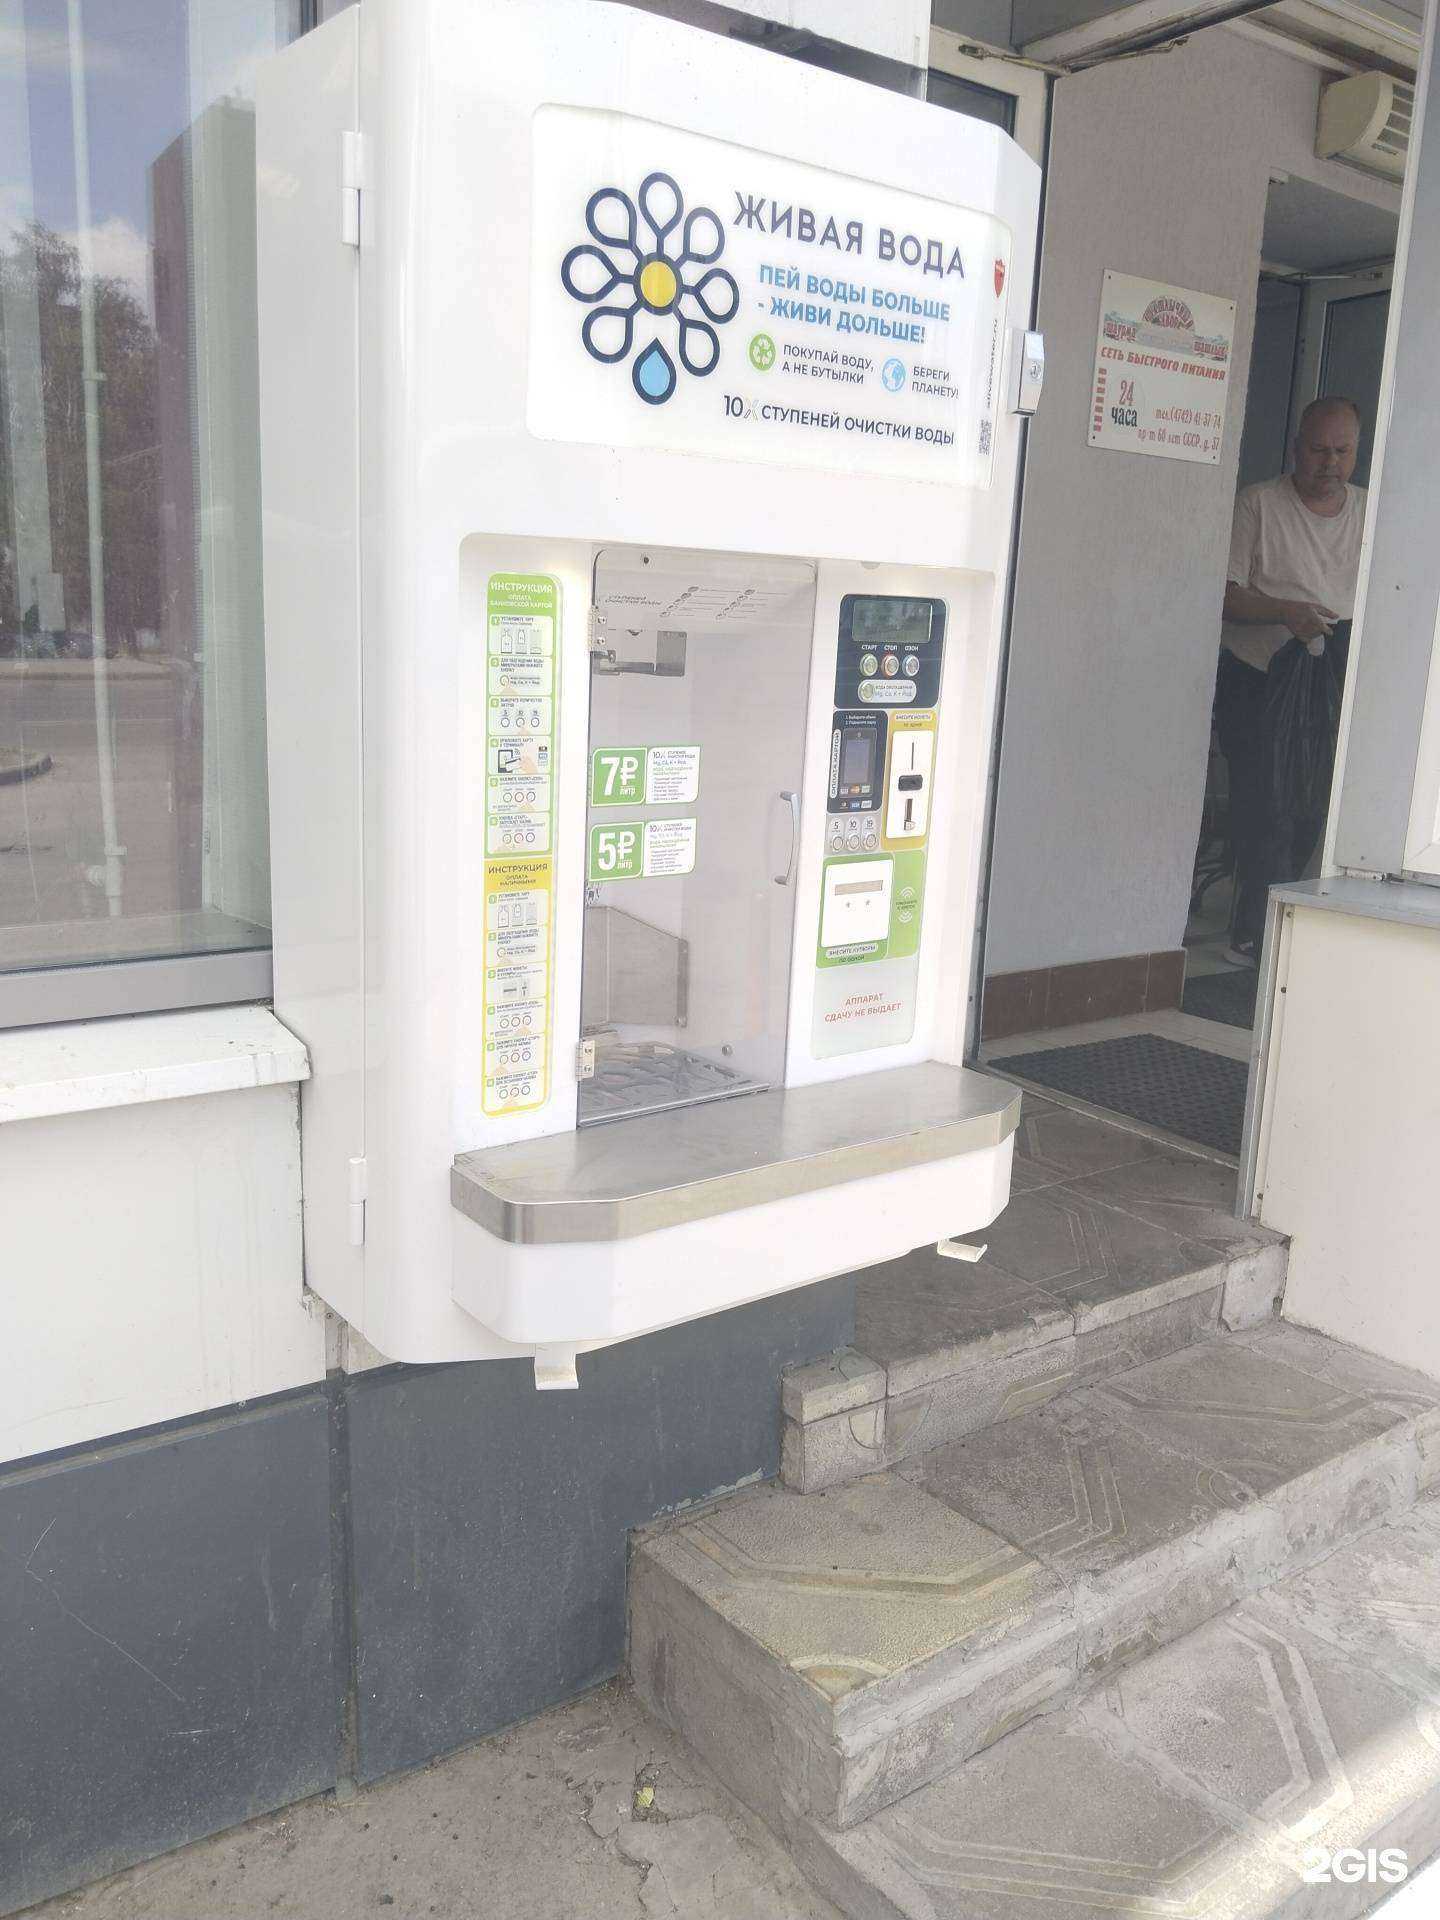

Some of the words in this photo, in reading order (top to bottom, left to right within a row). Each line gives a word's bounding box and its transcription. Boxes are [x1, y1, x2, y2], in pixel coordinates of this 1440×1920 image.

[733, 191, 864, 255] ЖИВАЯ
[878, 228, 965, 279] ВОДА
[759, 264, 800, 291] ПЕЙ
[806, 274, 866, 304] ВОДЫ
[872, 289, 951, 322] БОЛЬШЕ
[770, 296, 831, 326] ЖИВИ
[836, 310, 926, 344] ДОЛЬШЕ!
[783, 344, 839, 364] ПОКУПАЙ
[842, 354, 875, 373] ВОДУ,
[1101, 346, 1124, 360] СЕТЬ
[1127, 351, 1179, 371] БЫСТРОГО
[1181, 361, 1226, 381] ПИТАНИЯ
[782, 362, 790, 373] А
[793, 363, 808, 375] НЕ
[811, 366, 864, 384] БУТЫЛКИ
[913, 366, 951, 382] БЕРЕГИ
[911, 381, 959, 399] ПЛАНЕТУ!
[1118, 380, 1134, 406] 24
[761, 404, 840, 430] СТУПЕНЕЙ
[844, 417, 911, 439] ОЧИСТКИ
[915, 427, 954, 446] ВОДЫ
[1111, 406, 1137, 427] часа
[491, 582, 553, 593] ИНСТРУКЦИЯ
[834, 822, 839, 830] 5
[488, 863, 548, 874] ИНСТРУКЦИЯ
[845, 993, 884, 1007] АППАРАТ
[824, 1009, 853, 1022] СДАЧУ
[854, 1007, 866, 1018] НЕ
[867, 1003, 901, 1015] ВЫДАЕТ
